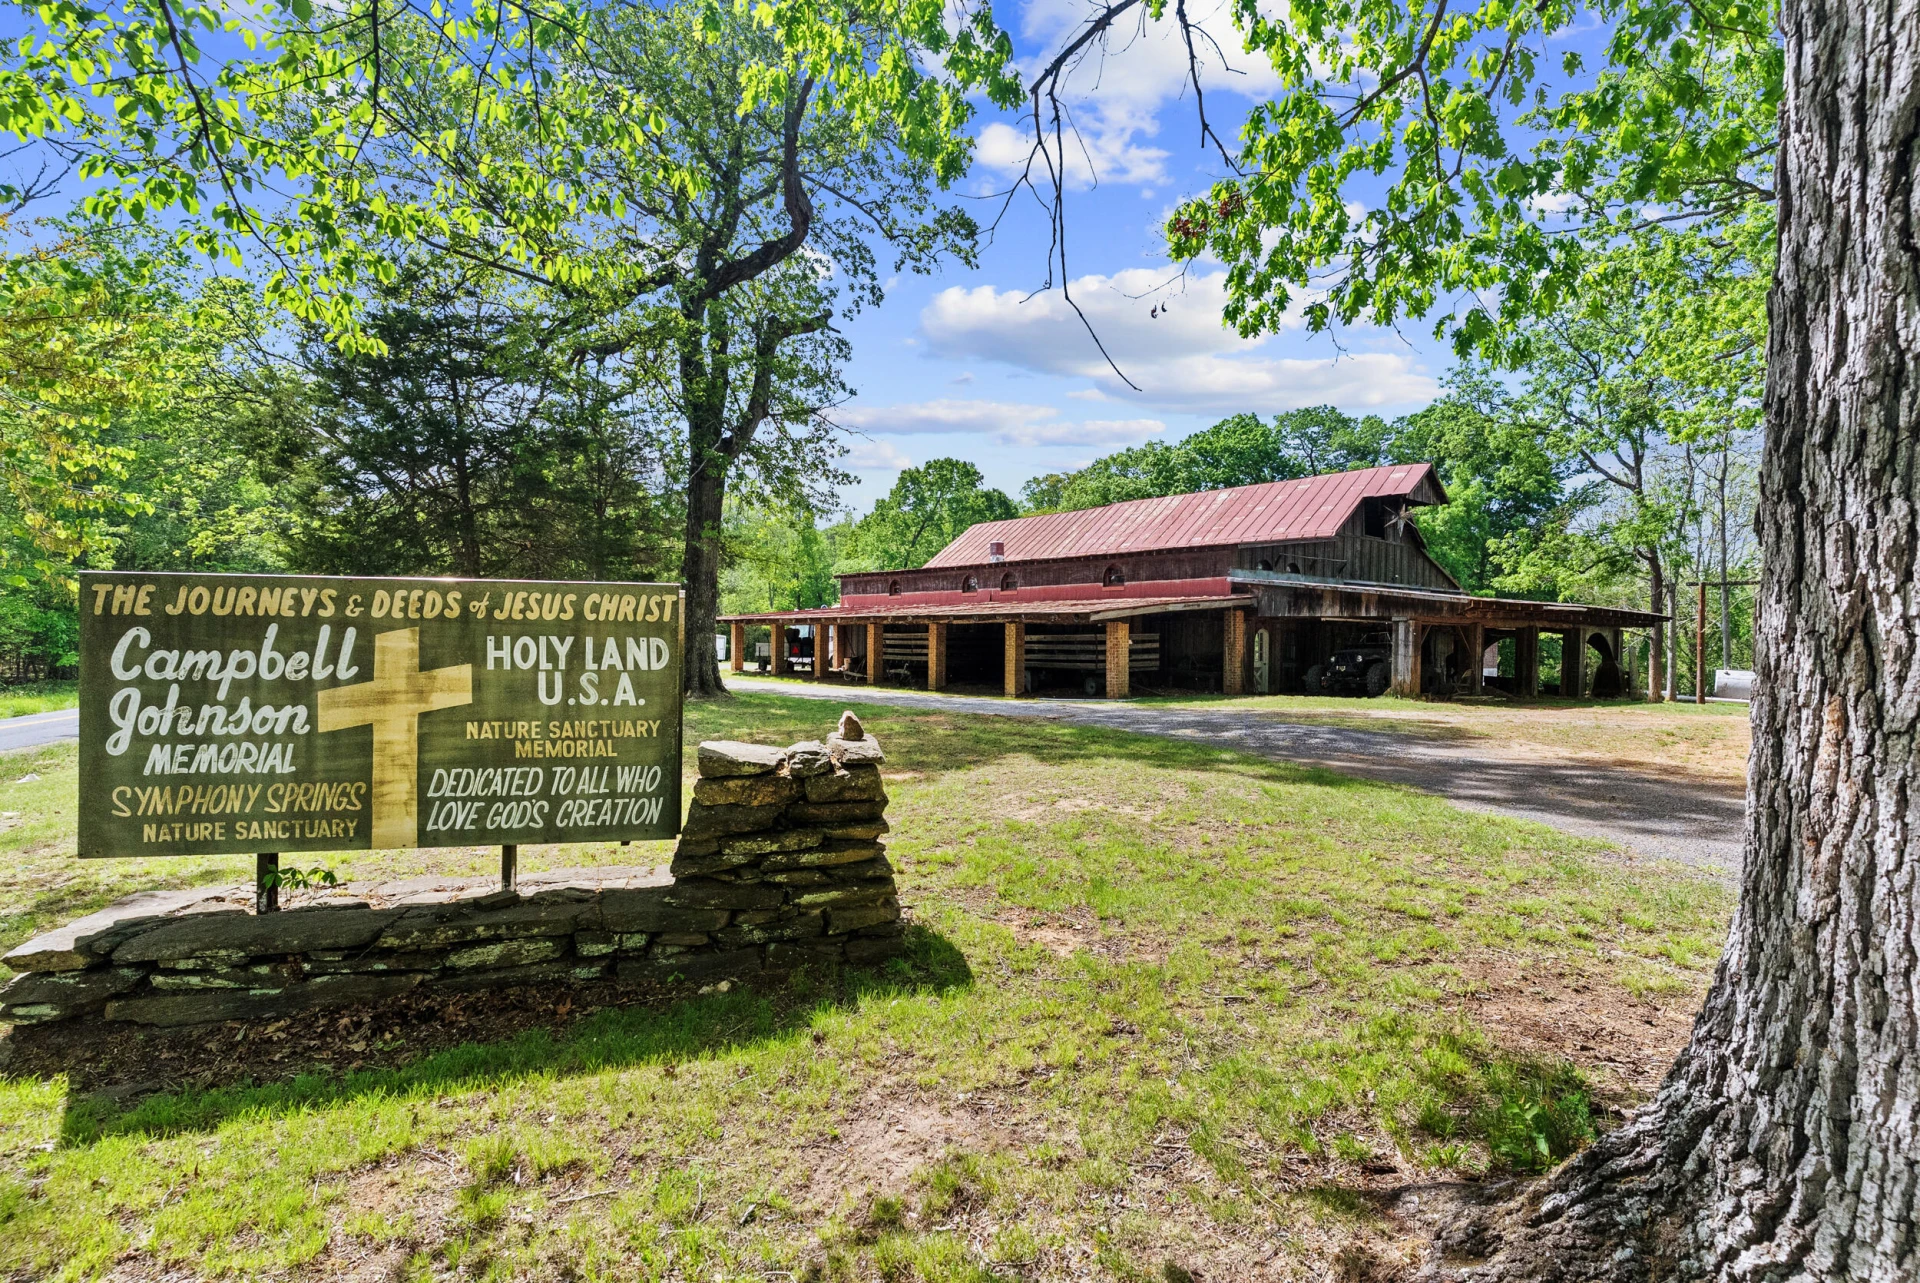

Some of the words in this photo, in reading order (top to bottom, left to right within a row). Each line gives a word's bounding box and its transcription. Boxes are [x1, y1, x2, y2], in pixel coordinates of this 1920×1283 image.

[92, 584, 156, 616] THE
[165, 585, 337, 617] JOURNEYS
[345, 594, 364, 617] &
[371, 590, 462, 619] DEEDS
[469, 592, 490, 620] of
[493, 592, 575, 621] JESUS
[583, 594, 677, 622] CHRIST
[110, 623, 359, 701] Campbell
[486, 636, 575, 670] HOLY
[585, 637, 670, 671] LAND
[537, 672, 646, 706] U.S.A.
[105, 683, 311, 756] Johnson
[466, 721, 542, 740] NATURE
[549, 720, 661, 739] SANCTUARY
[143, 742, 297, 776] MEMORIAL
[515, 739, 618, 759] MEMORIAL
[427, 766, 544, 798] DEDICATED
[551, 766, 576, 796] TO
[576, 766, 610, 795] ALL
[616, 765, 662, 794] WHO
[111, 783, 263, 818] SYMPHONY
[264, 781, 367, 813] SPRINGS
[426, 801, 485, 831] LOVE
[555, 797, 664, 828] CREATION
[143, 821, 226, 843] NATURE
[235, 818, 359, 840] SANCTUARY
